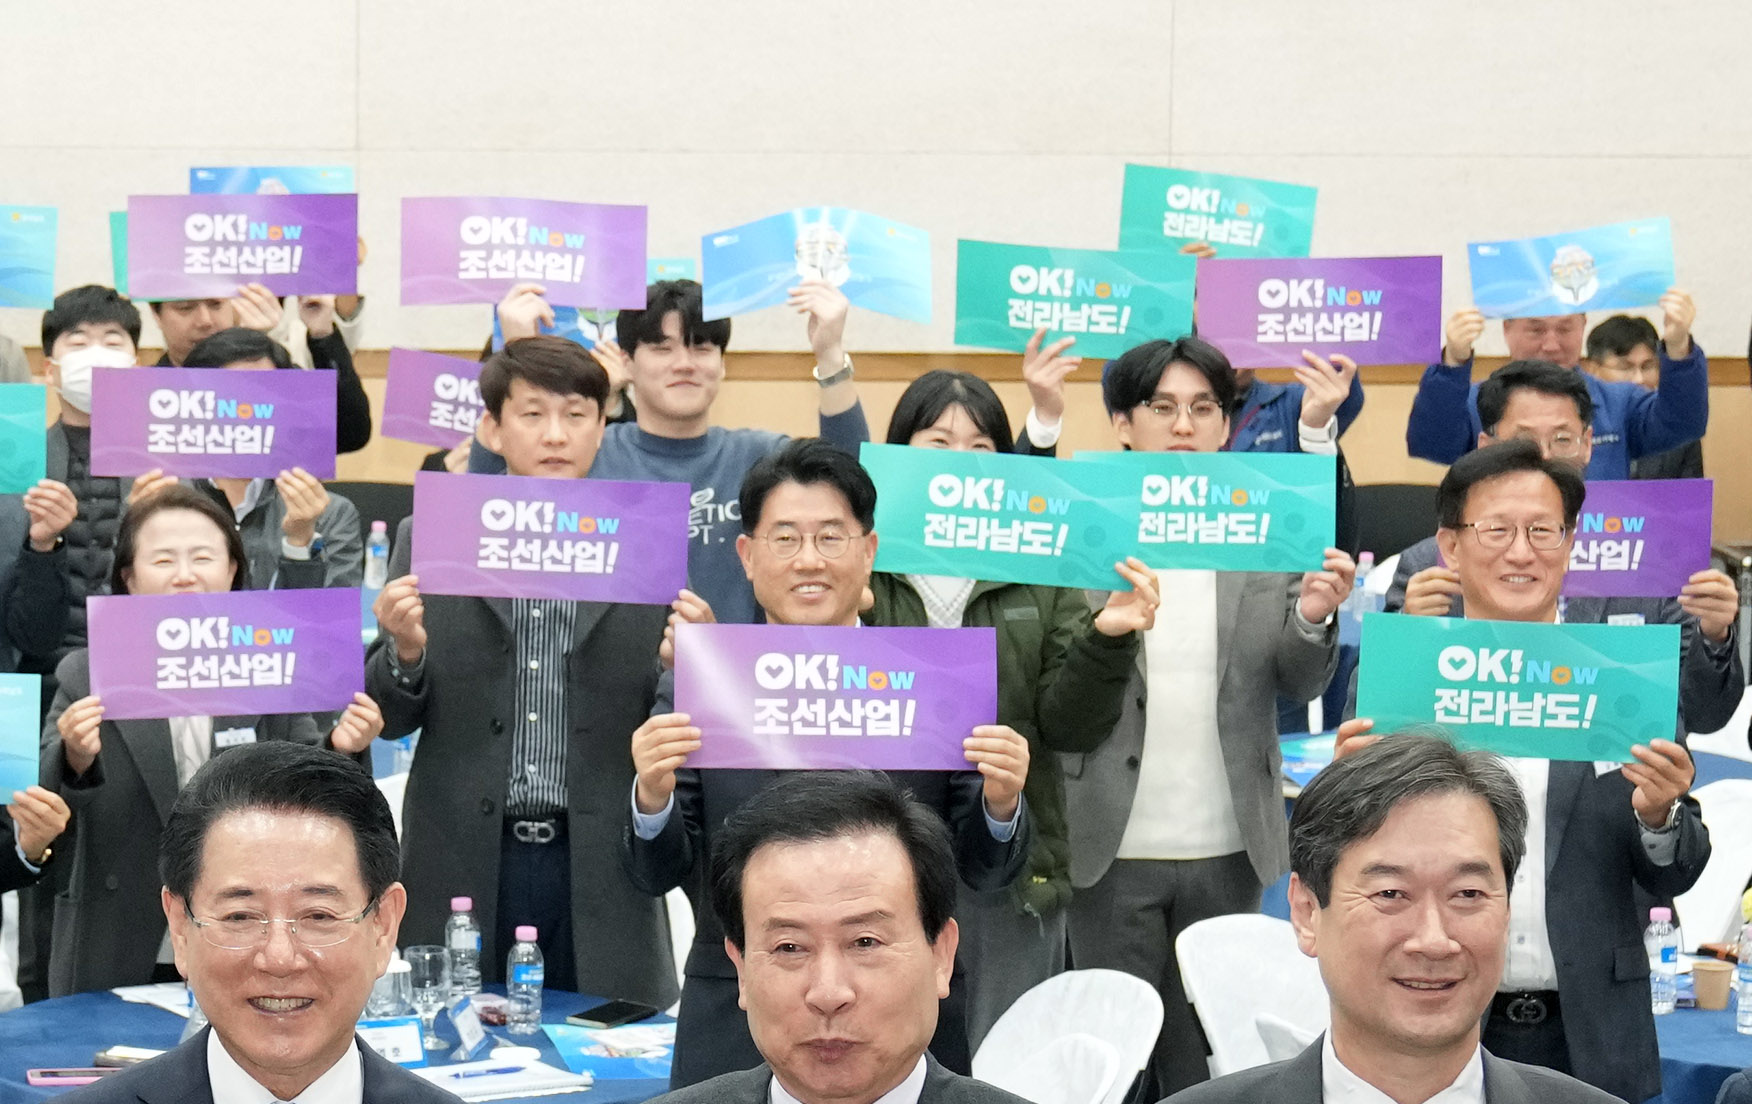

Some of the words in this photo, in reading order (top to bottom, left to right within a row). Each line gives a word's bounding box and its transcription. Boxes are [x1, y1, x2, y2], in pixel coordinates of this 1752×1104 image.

[1167, 185, 1219, 212] OK!
[1220, 196, 1265, 217] Now
[184, 214, 246, 241] OK!
[249, 221, 301, 240] Now
[460, 217, 527, 245] OK!
[529, 227, 585, 249] Now
[1163, 212, 1263, 247] 전라남도!
[184, 246, 302, 275] 조선산업!
[459, 250, 584, 283] 조선산업!
[1010, 265, 1072, 295] OK!
[1075, 280, 1131, 298] Now
[1258, 280, 1323, 307] OK!
[1327, 287, 1382, 306] Now
[1008, 298, 1130, 334] 전라남도!
[1258, 312, 1381, 343] 조선산업!
[149, 389, 214, 419] OK!
[217, 399, 273, 419] Now
[434, 373, 485, 406] OK
[148, 423, 275, 454] 조선산업!
[929, 474, 1005, 511] OK!
[1006, 491, 1070, 514] Now
[1142, 474, 1208, 505] OK!
[1211, 484, 1269, 506] Now
[481, 499, 554, 531] OK!
[557, 512, 619, 532] Now
[1139, 513, 1270, 545] 전라남도!
[1583, 513, 1645, 534] Now
[924, 513, 1068, 556] 전라남도!
[478, 538, 619, 574] 조선산업!
[1569, 540, 1645, 573] 산업!
[157, 617, 229, 648] OK!
[232, 625, 294, 646] Now
[157, 652, 296, 690] 조선산업!
[755, 654, 837, 690] OK!
[843, 665, 915, 690] Now
[1438, 646, 1524, 683] OK!
[1526, 662, 1599, 685] Now
[753, 701, 915, 737] 조선산업!
[1433, 688, 1596, 729] 전라남도!
